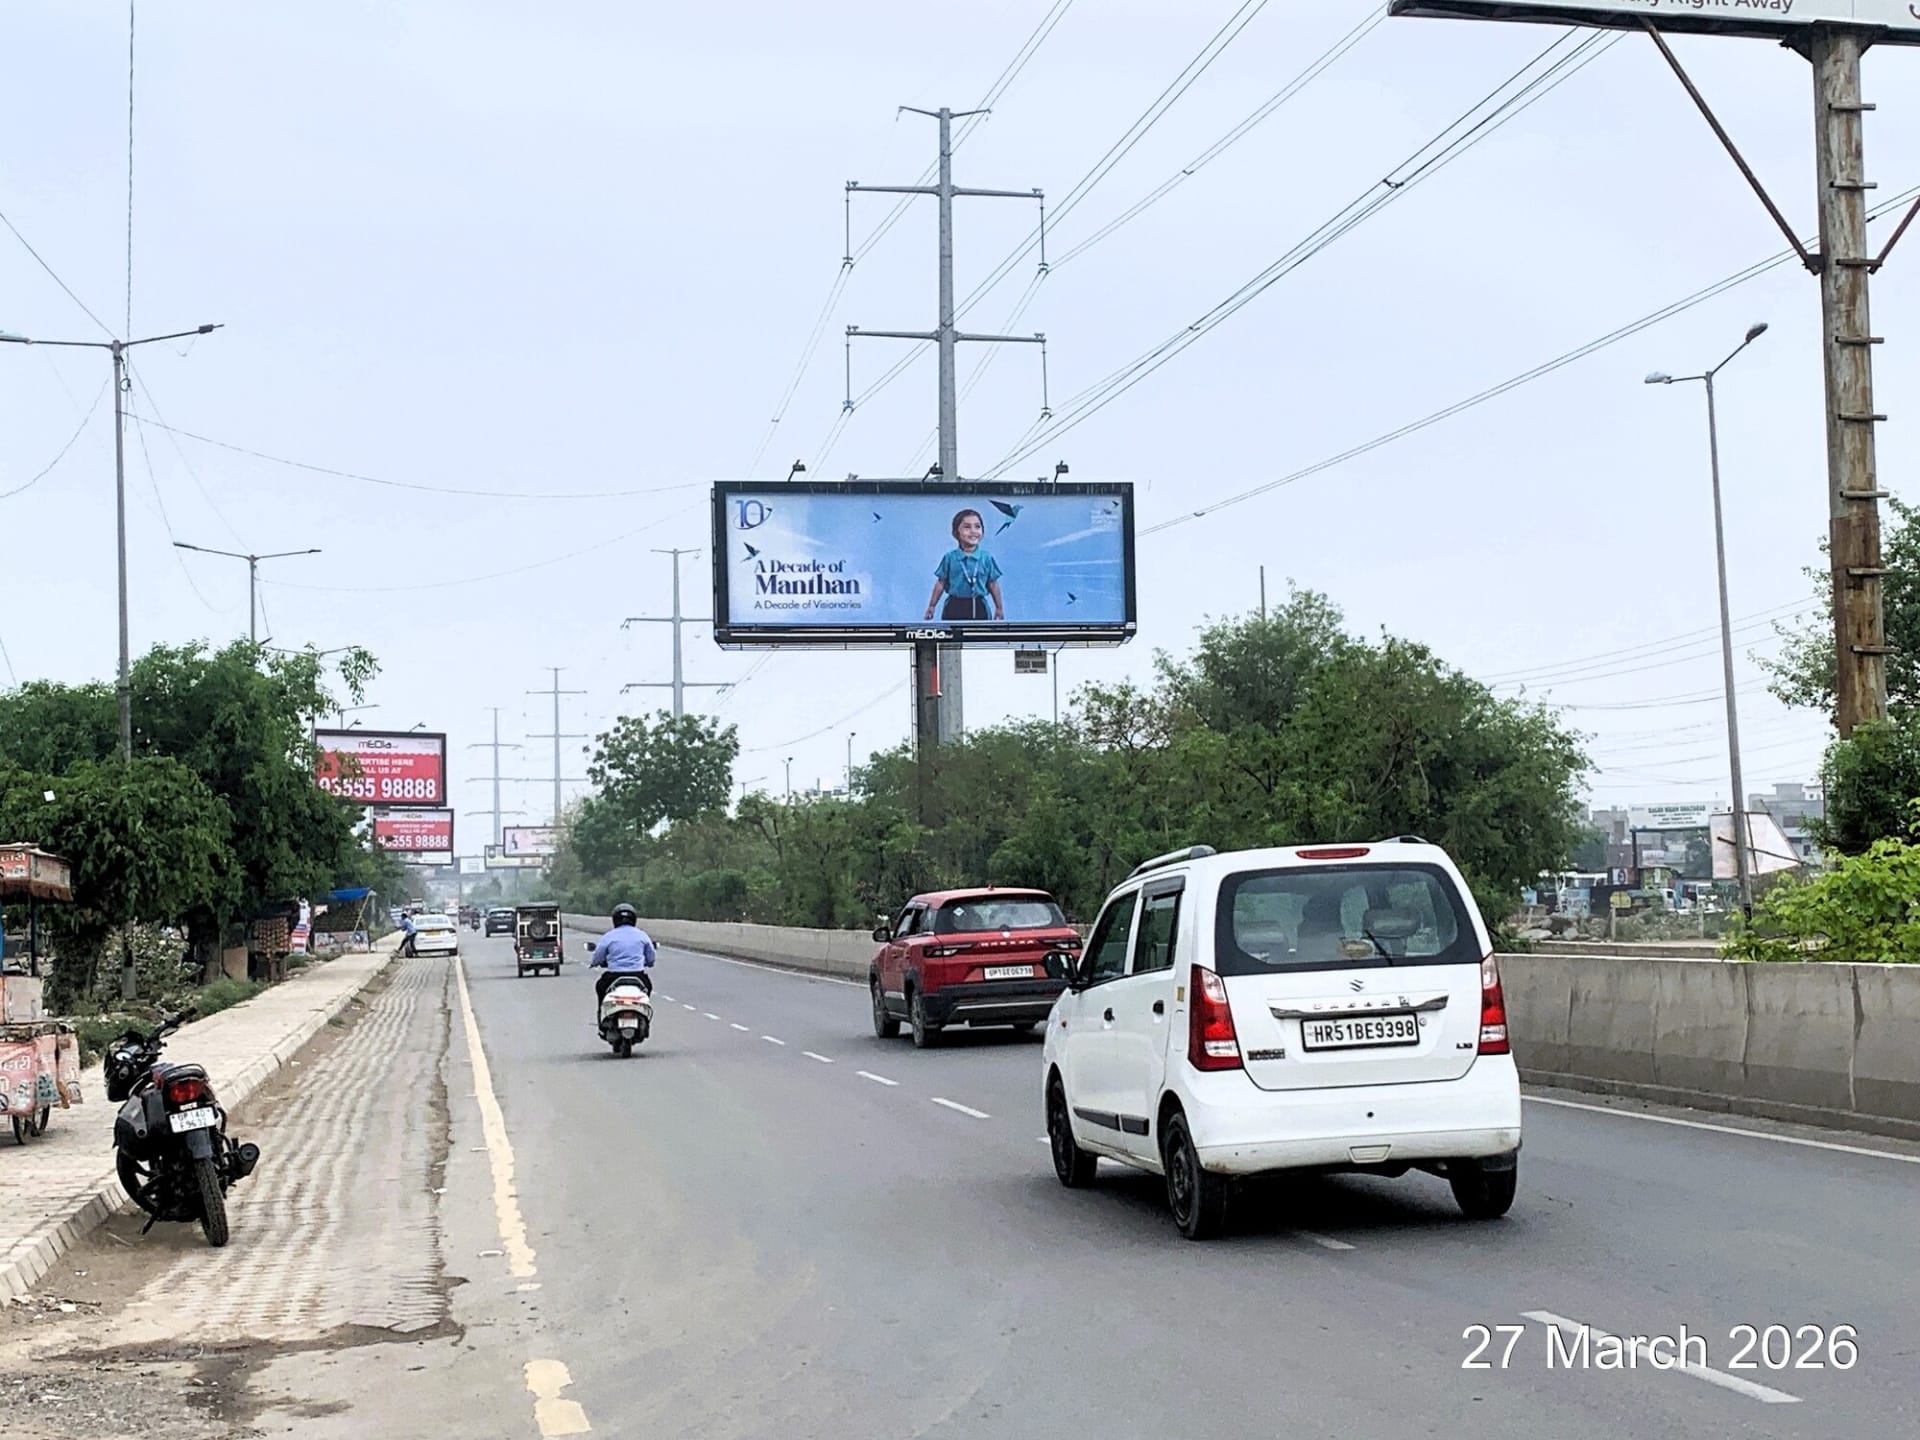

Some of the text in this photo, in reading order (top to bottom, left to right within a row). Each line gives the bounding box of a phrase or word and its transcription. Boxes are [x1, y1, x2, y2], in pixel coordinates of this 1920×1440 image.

[735, 500, 764, 528] 10
[754, 559, 846, 573] A Decade of
[755, 573, 861, 594] Manthan
[754, 600, 862, 609] A Decade of Visionaries
[381, 778, 437, 799] 98888
[415, 835, 449, 847] 98888
[1313, 1020, 1415, 1043] HR51BE9398
